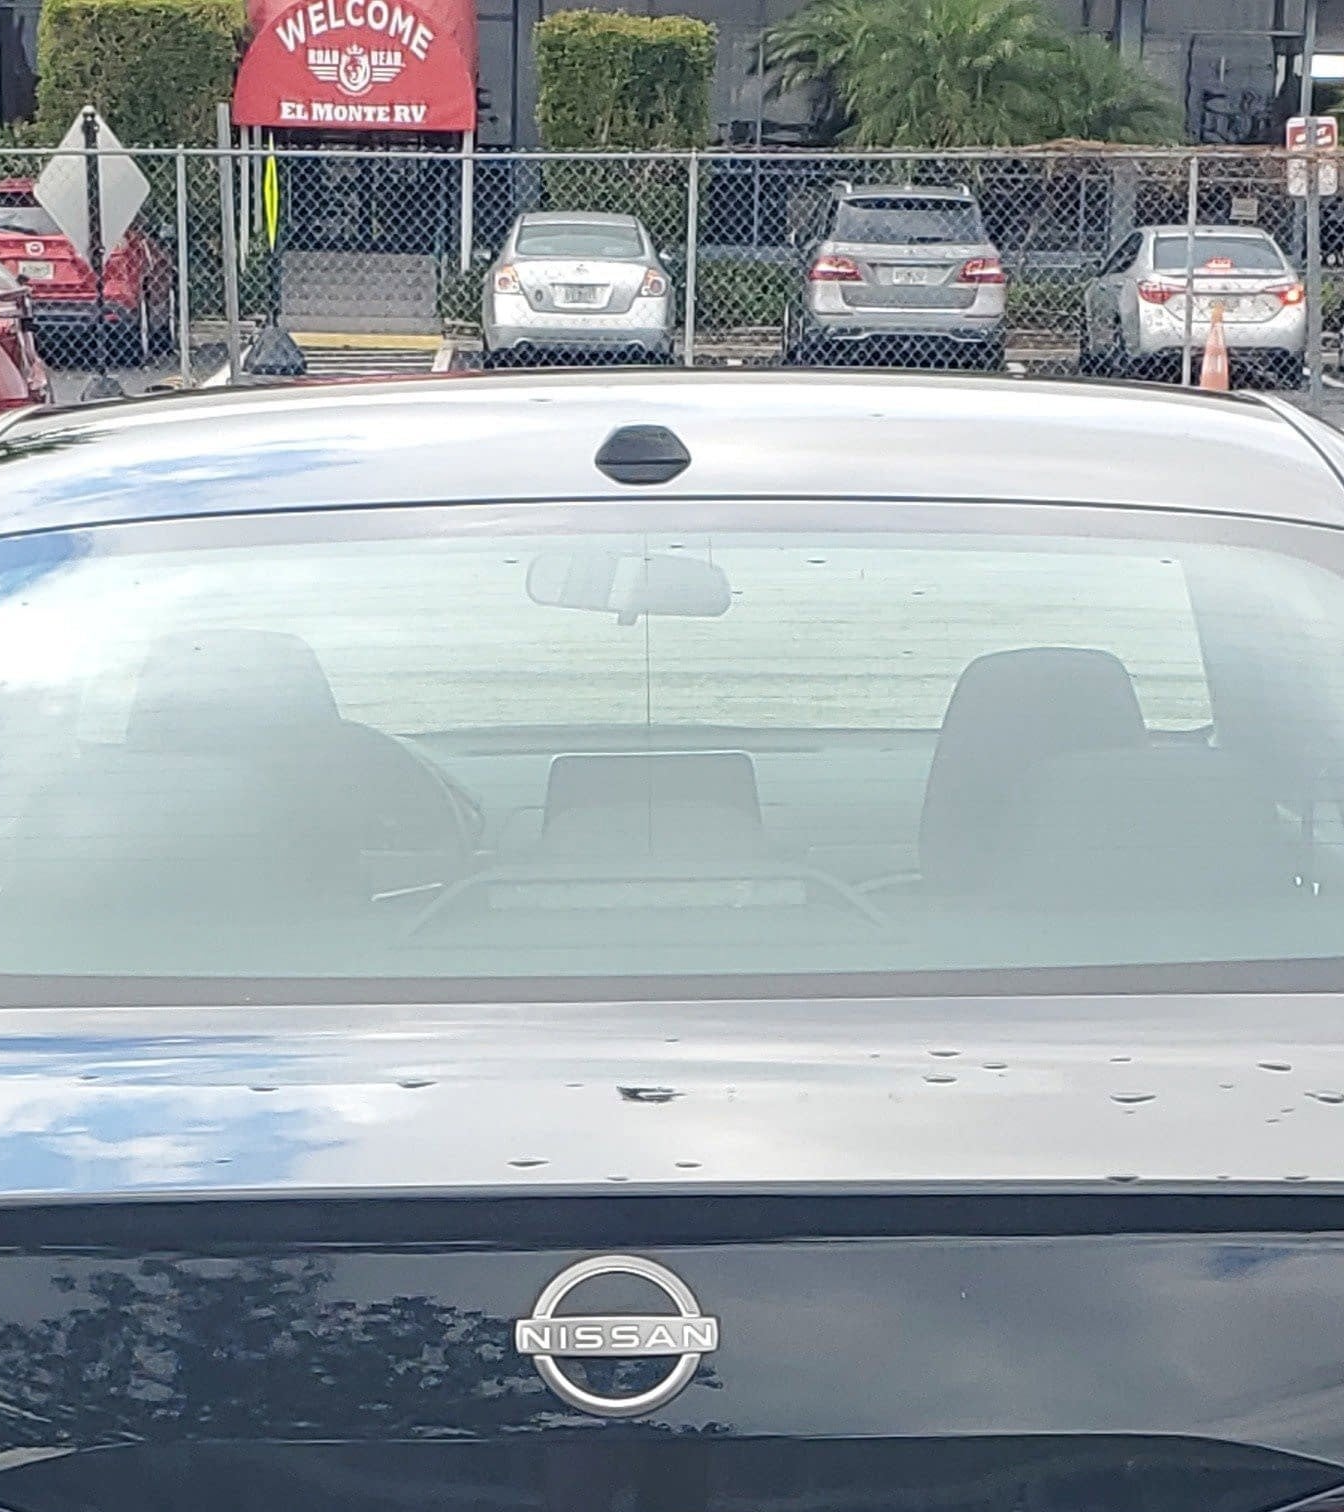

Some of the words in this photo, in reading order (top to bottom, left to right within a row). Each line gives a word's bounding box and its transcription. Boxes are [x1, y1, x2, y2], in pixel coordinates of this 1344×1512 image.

[275, 0, 435, 60] WELCOME
[280, 101, 308, 120] EL
[312, 103, 389, 122] MONTE
[392, 105, 427, 123] RV
[522, 1324, 712, 1349] NISSAN
